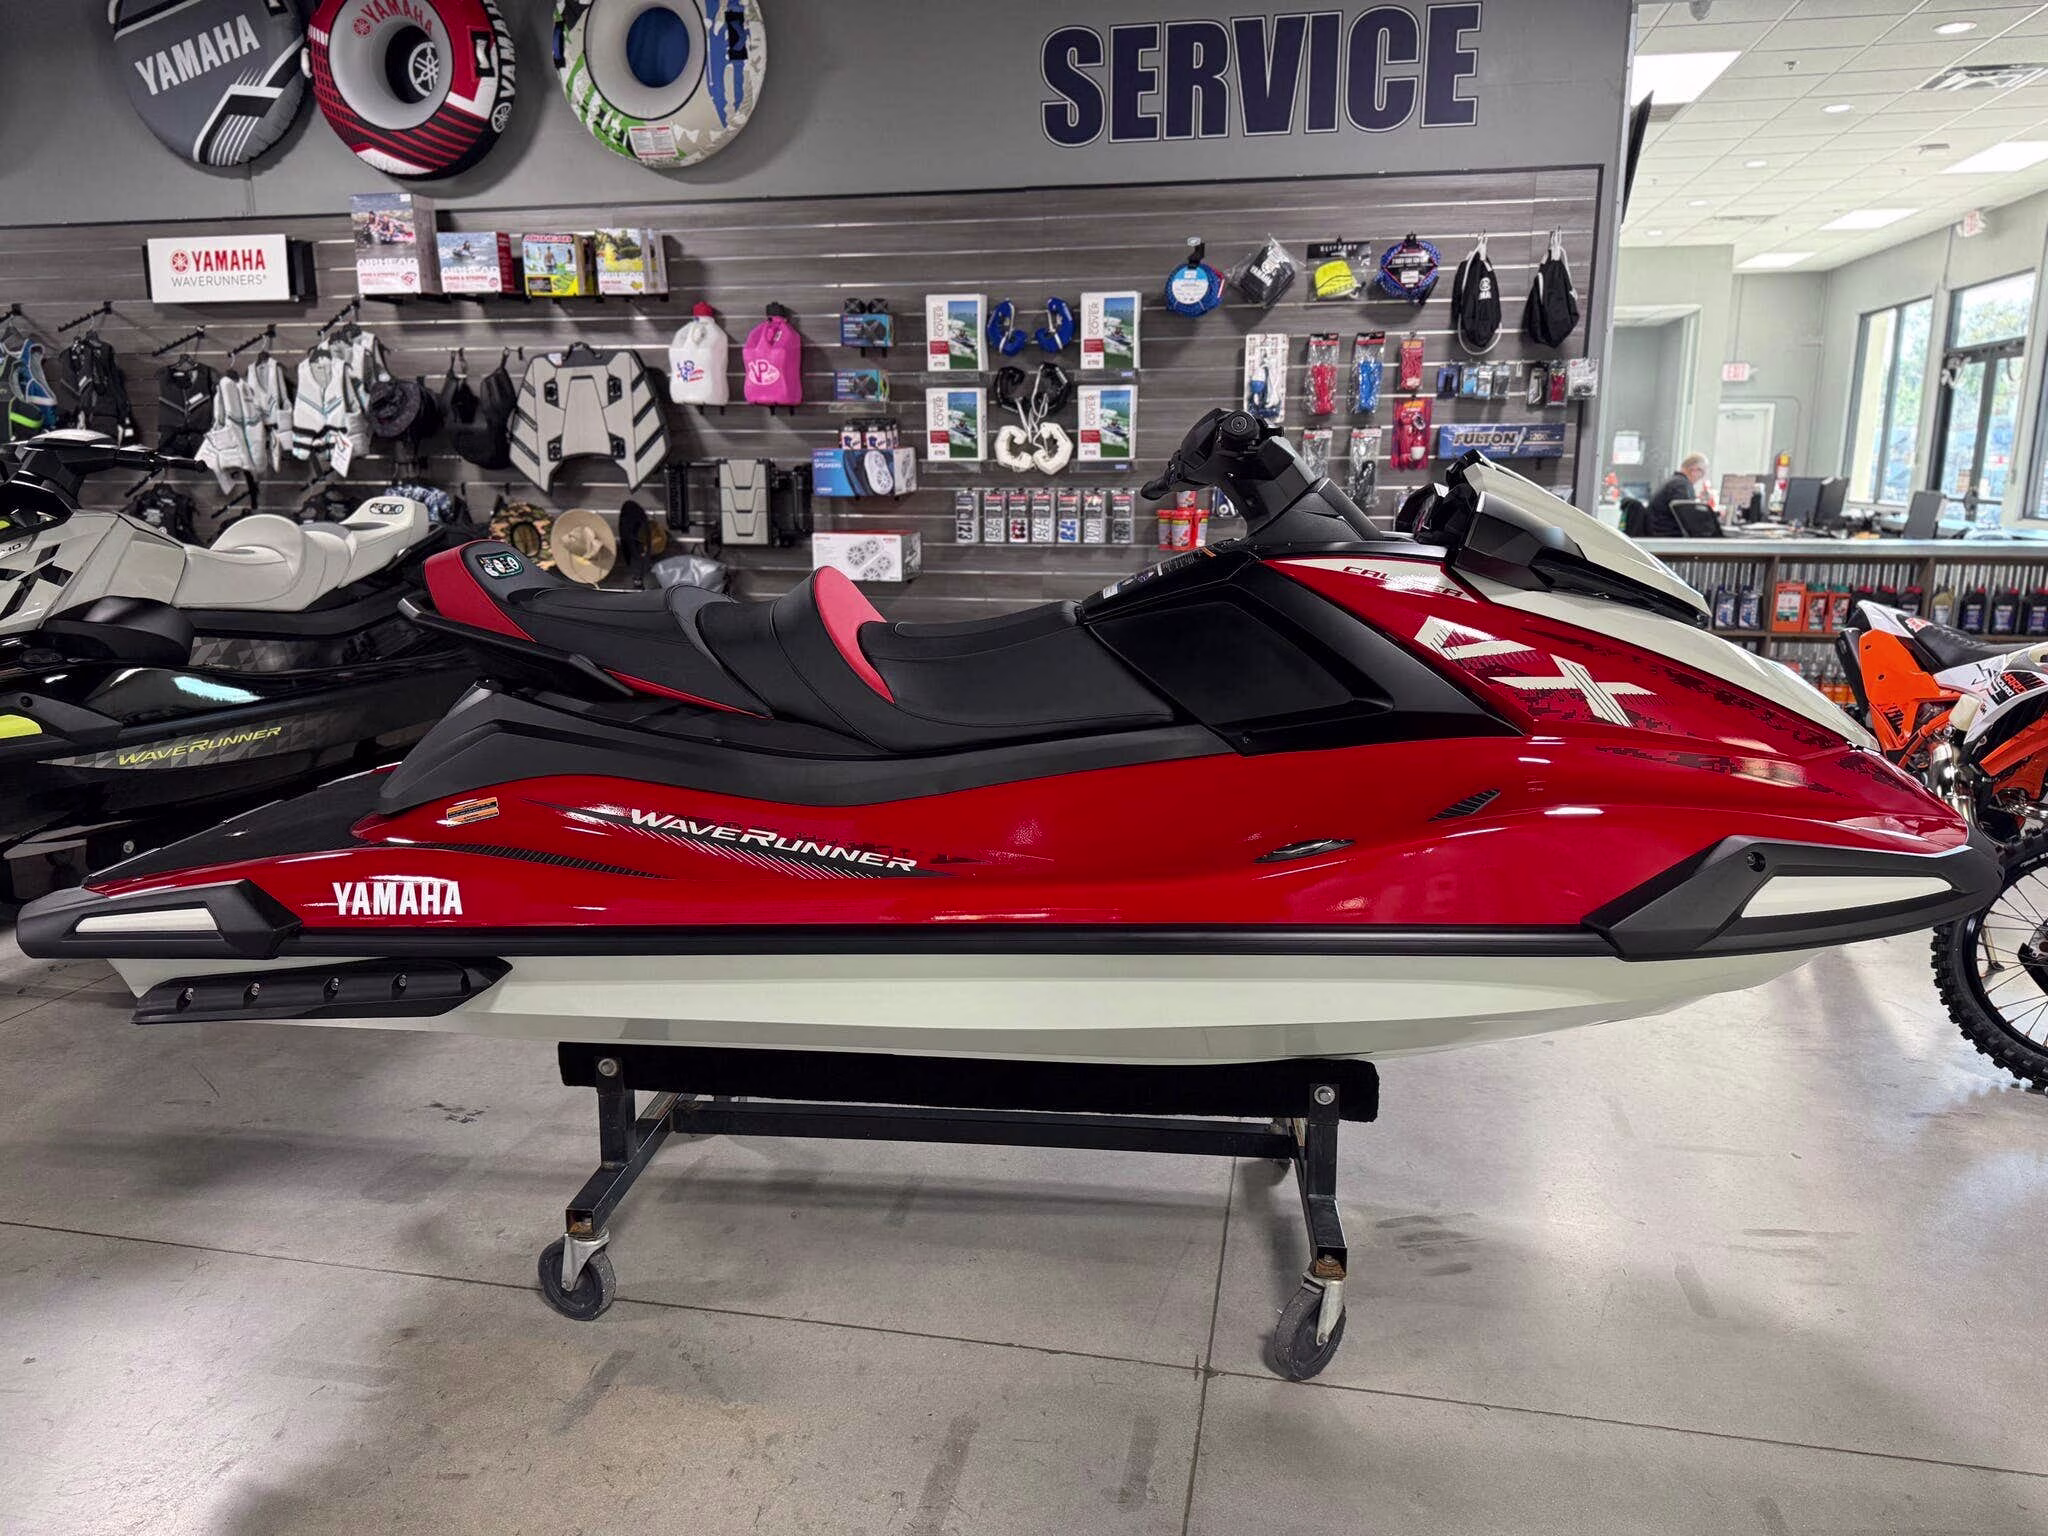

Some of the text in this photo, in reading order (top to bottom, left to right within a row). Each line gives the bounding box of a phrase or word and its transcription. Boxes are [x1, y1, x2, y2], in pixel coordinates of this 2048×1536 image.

[361, 0, 433, 36] YAMAHA
[134, 14, 260, 95] YAMAHA
[1040, 2, 1483, 148] SERVICE
[192, 249, 266, 272] YAMAHA
[1453, 431, 1518, 446] FULTON
[118, 727, 282, 766] WAVERUNNER
[631, 808, 917, 871] WAVERUNNER
[332, 880, 463, 916] YAMAHA
